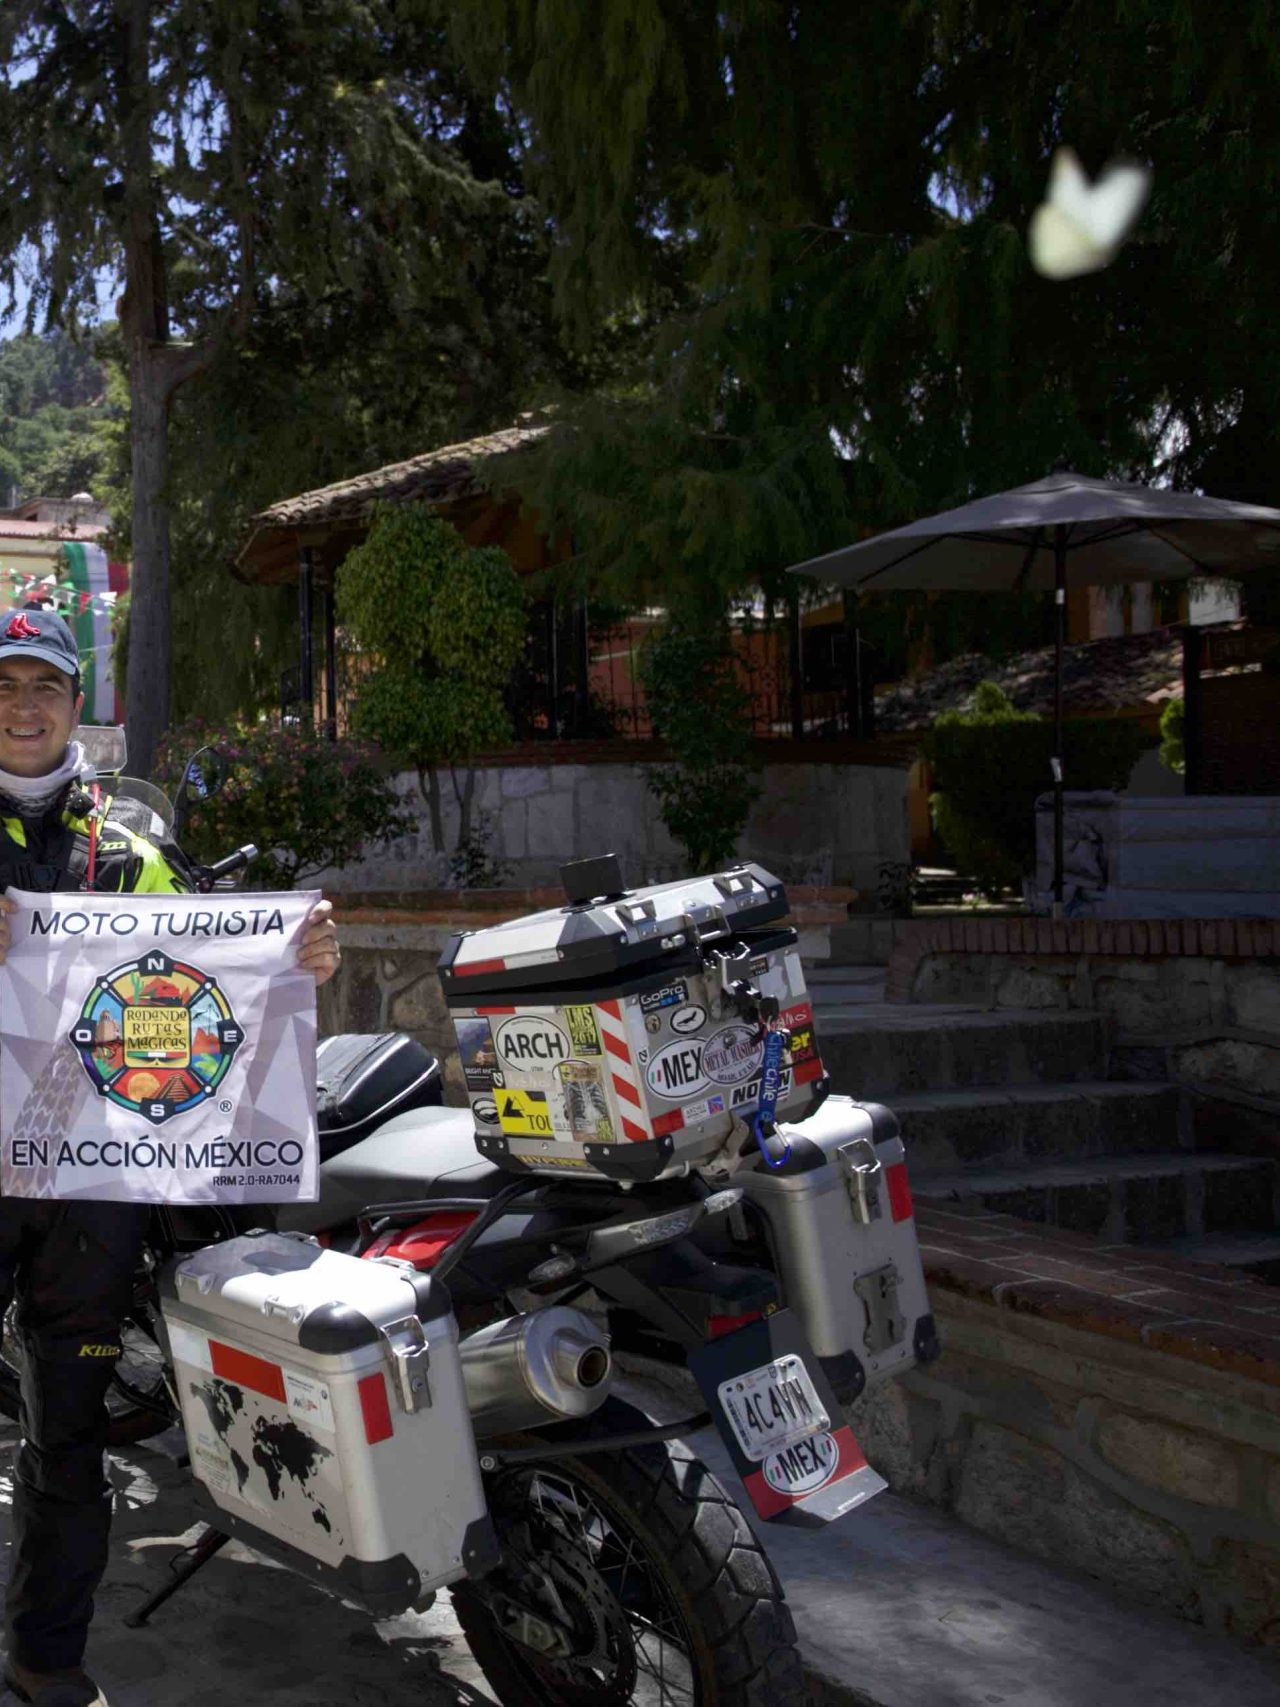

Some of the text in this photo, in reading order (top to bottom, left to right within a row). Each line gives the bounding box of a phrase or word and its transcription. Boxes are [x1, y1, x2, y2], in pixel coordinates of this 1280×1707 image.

[31, 908, 284, 937] MOTO TURISTA
[148, 958, 164, 970] N
[641, 985, 685, 1004] GoPro
[75, 1029, 92, 1042] O
[224, 1030, 237, 1042] E
[504, 1033, 565, 1059] ARCH
[662, 1047, 705, 1089] MEX
[150, 1103, 165, 1117] S
[12, 1135, 304, 1169] EN ACCIÓN MÉXICO
[213, 1175, 237, 1187] RRM
[776, 1437, 826, 1484] MEX
